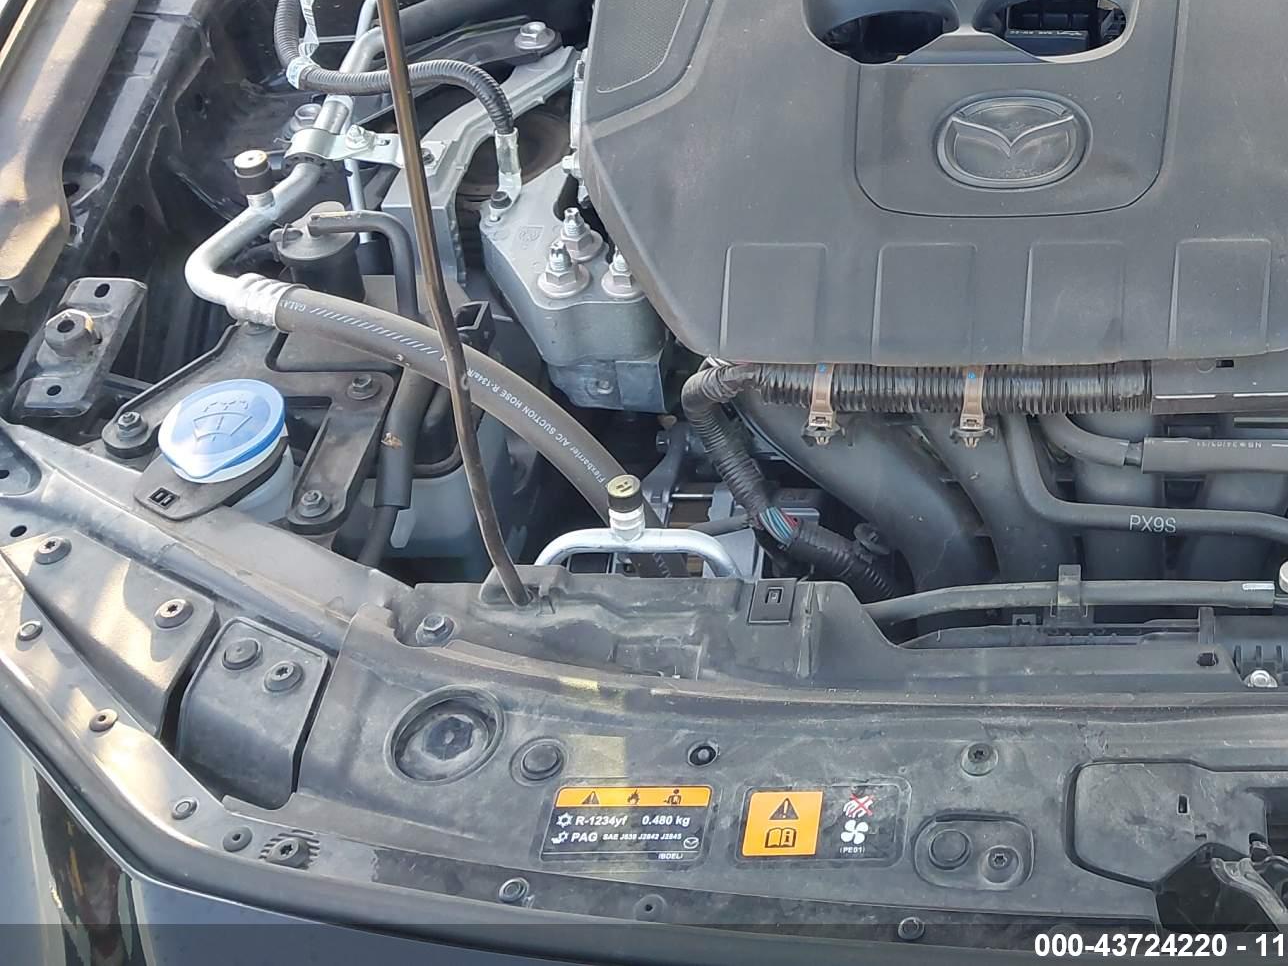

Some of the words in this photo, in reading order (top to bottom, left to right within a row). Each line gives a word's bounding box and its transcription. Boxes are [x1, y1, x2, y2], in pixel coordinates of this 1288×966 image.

[500, 388, 523, 410] HOSE
[521, 405, 557, 436] SUCTION
[555, 432, 571, 447] A/C
[1129, 514, 1177, 533] PX9S
[575, 815, 628, 828] R-1234yf
[642, 815, 673, 826] 0.480
[675, 815, 691, 828] kg
[570, 832, 599, 843] PAG
[602, 832, 619, 841] SAE
